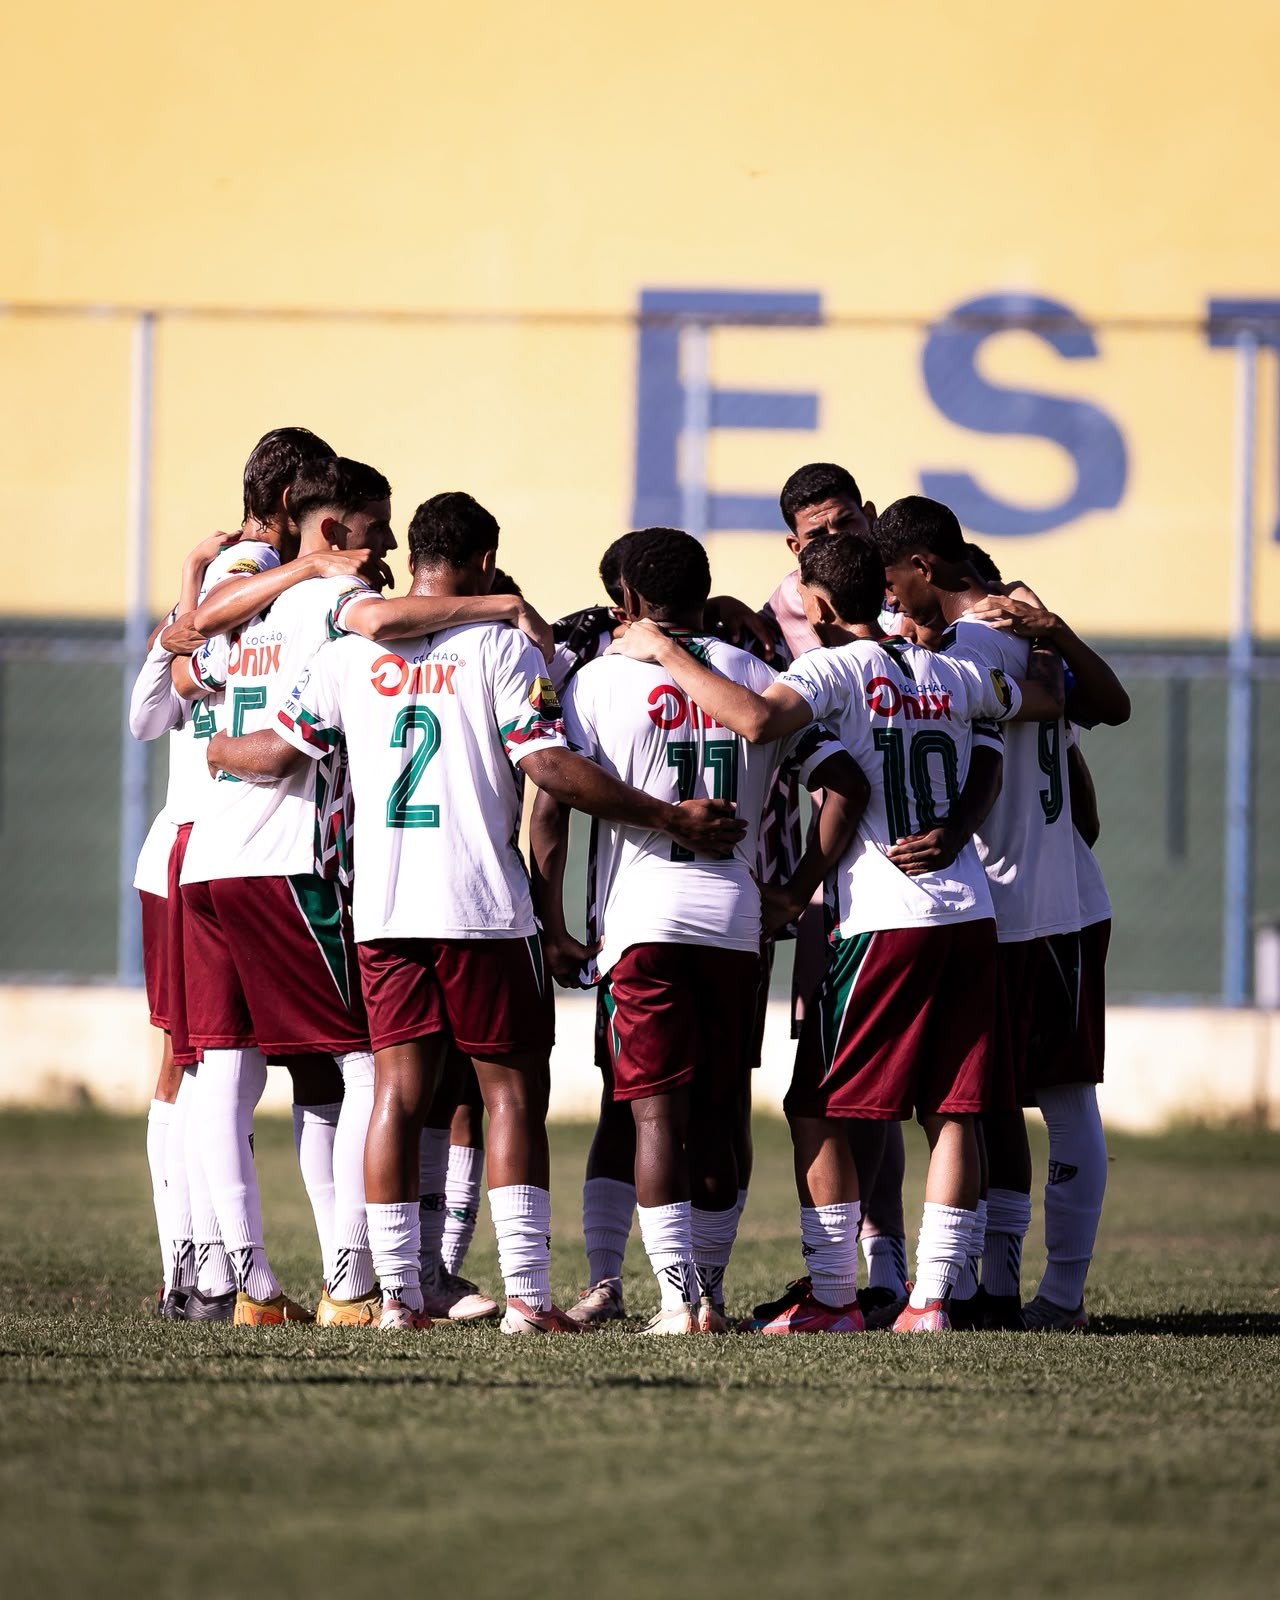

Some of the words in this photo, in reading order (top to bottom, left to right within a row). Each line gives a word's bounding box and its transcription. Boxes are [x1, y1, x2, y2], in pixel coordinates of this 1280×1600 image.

[385, 704, 441, 828] 2
[666, 739, 739, 862] 11
[872, 727, 960, 847] 10
[1037, 720, 1064, 825] 9
